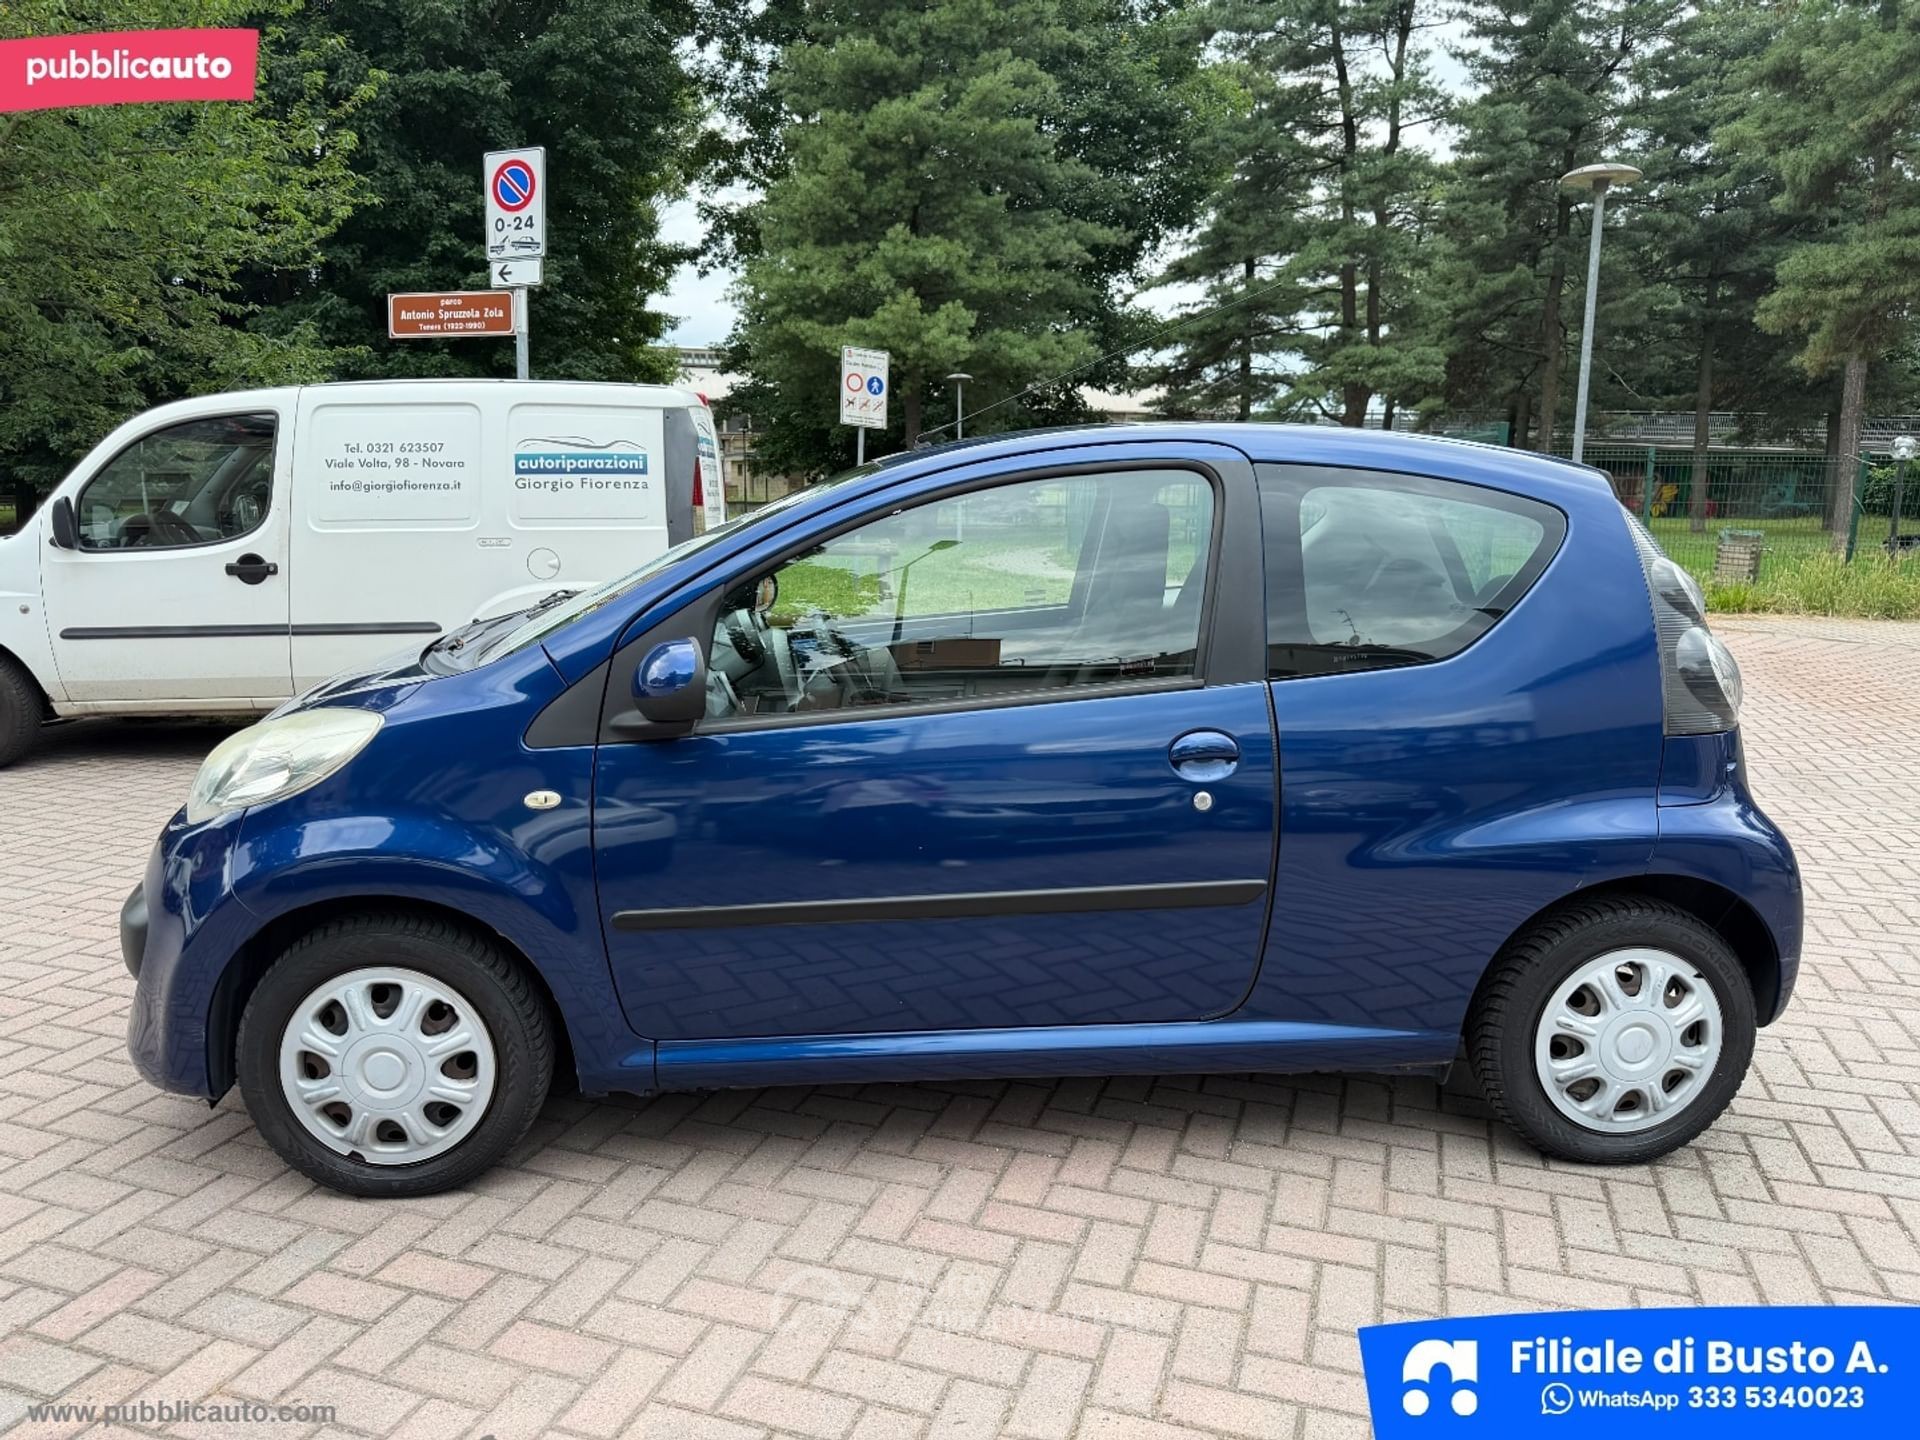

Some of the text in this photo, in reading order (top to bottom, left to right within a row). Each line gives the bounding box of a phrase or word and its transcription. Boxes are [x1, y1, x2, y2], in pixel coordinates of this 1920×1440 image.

[400, 307, 504, 320] Antonio Spruzzola Zola
[344, 443, 445, 454] Tel. 0321 623507
[325, 458, 355, 469] Viale
[358, 458, 391, 470] Volta,
[394, 457, 410, 469] 98
[422, 457, 465, 469] Novara
[518, 454, 644, 472] autoriparazioni
[329, 480, 462, 493] info@giorgiofiorenza.it
[514, 477, 649, 492] Giorgio Fiorenza
